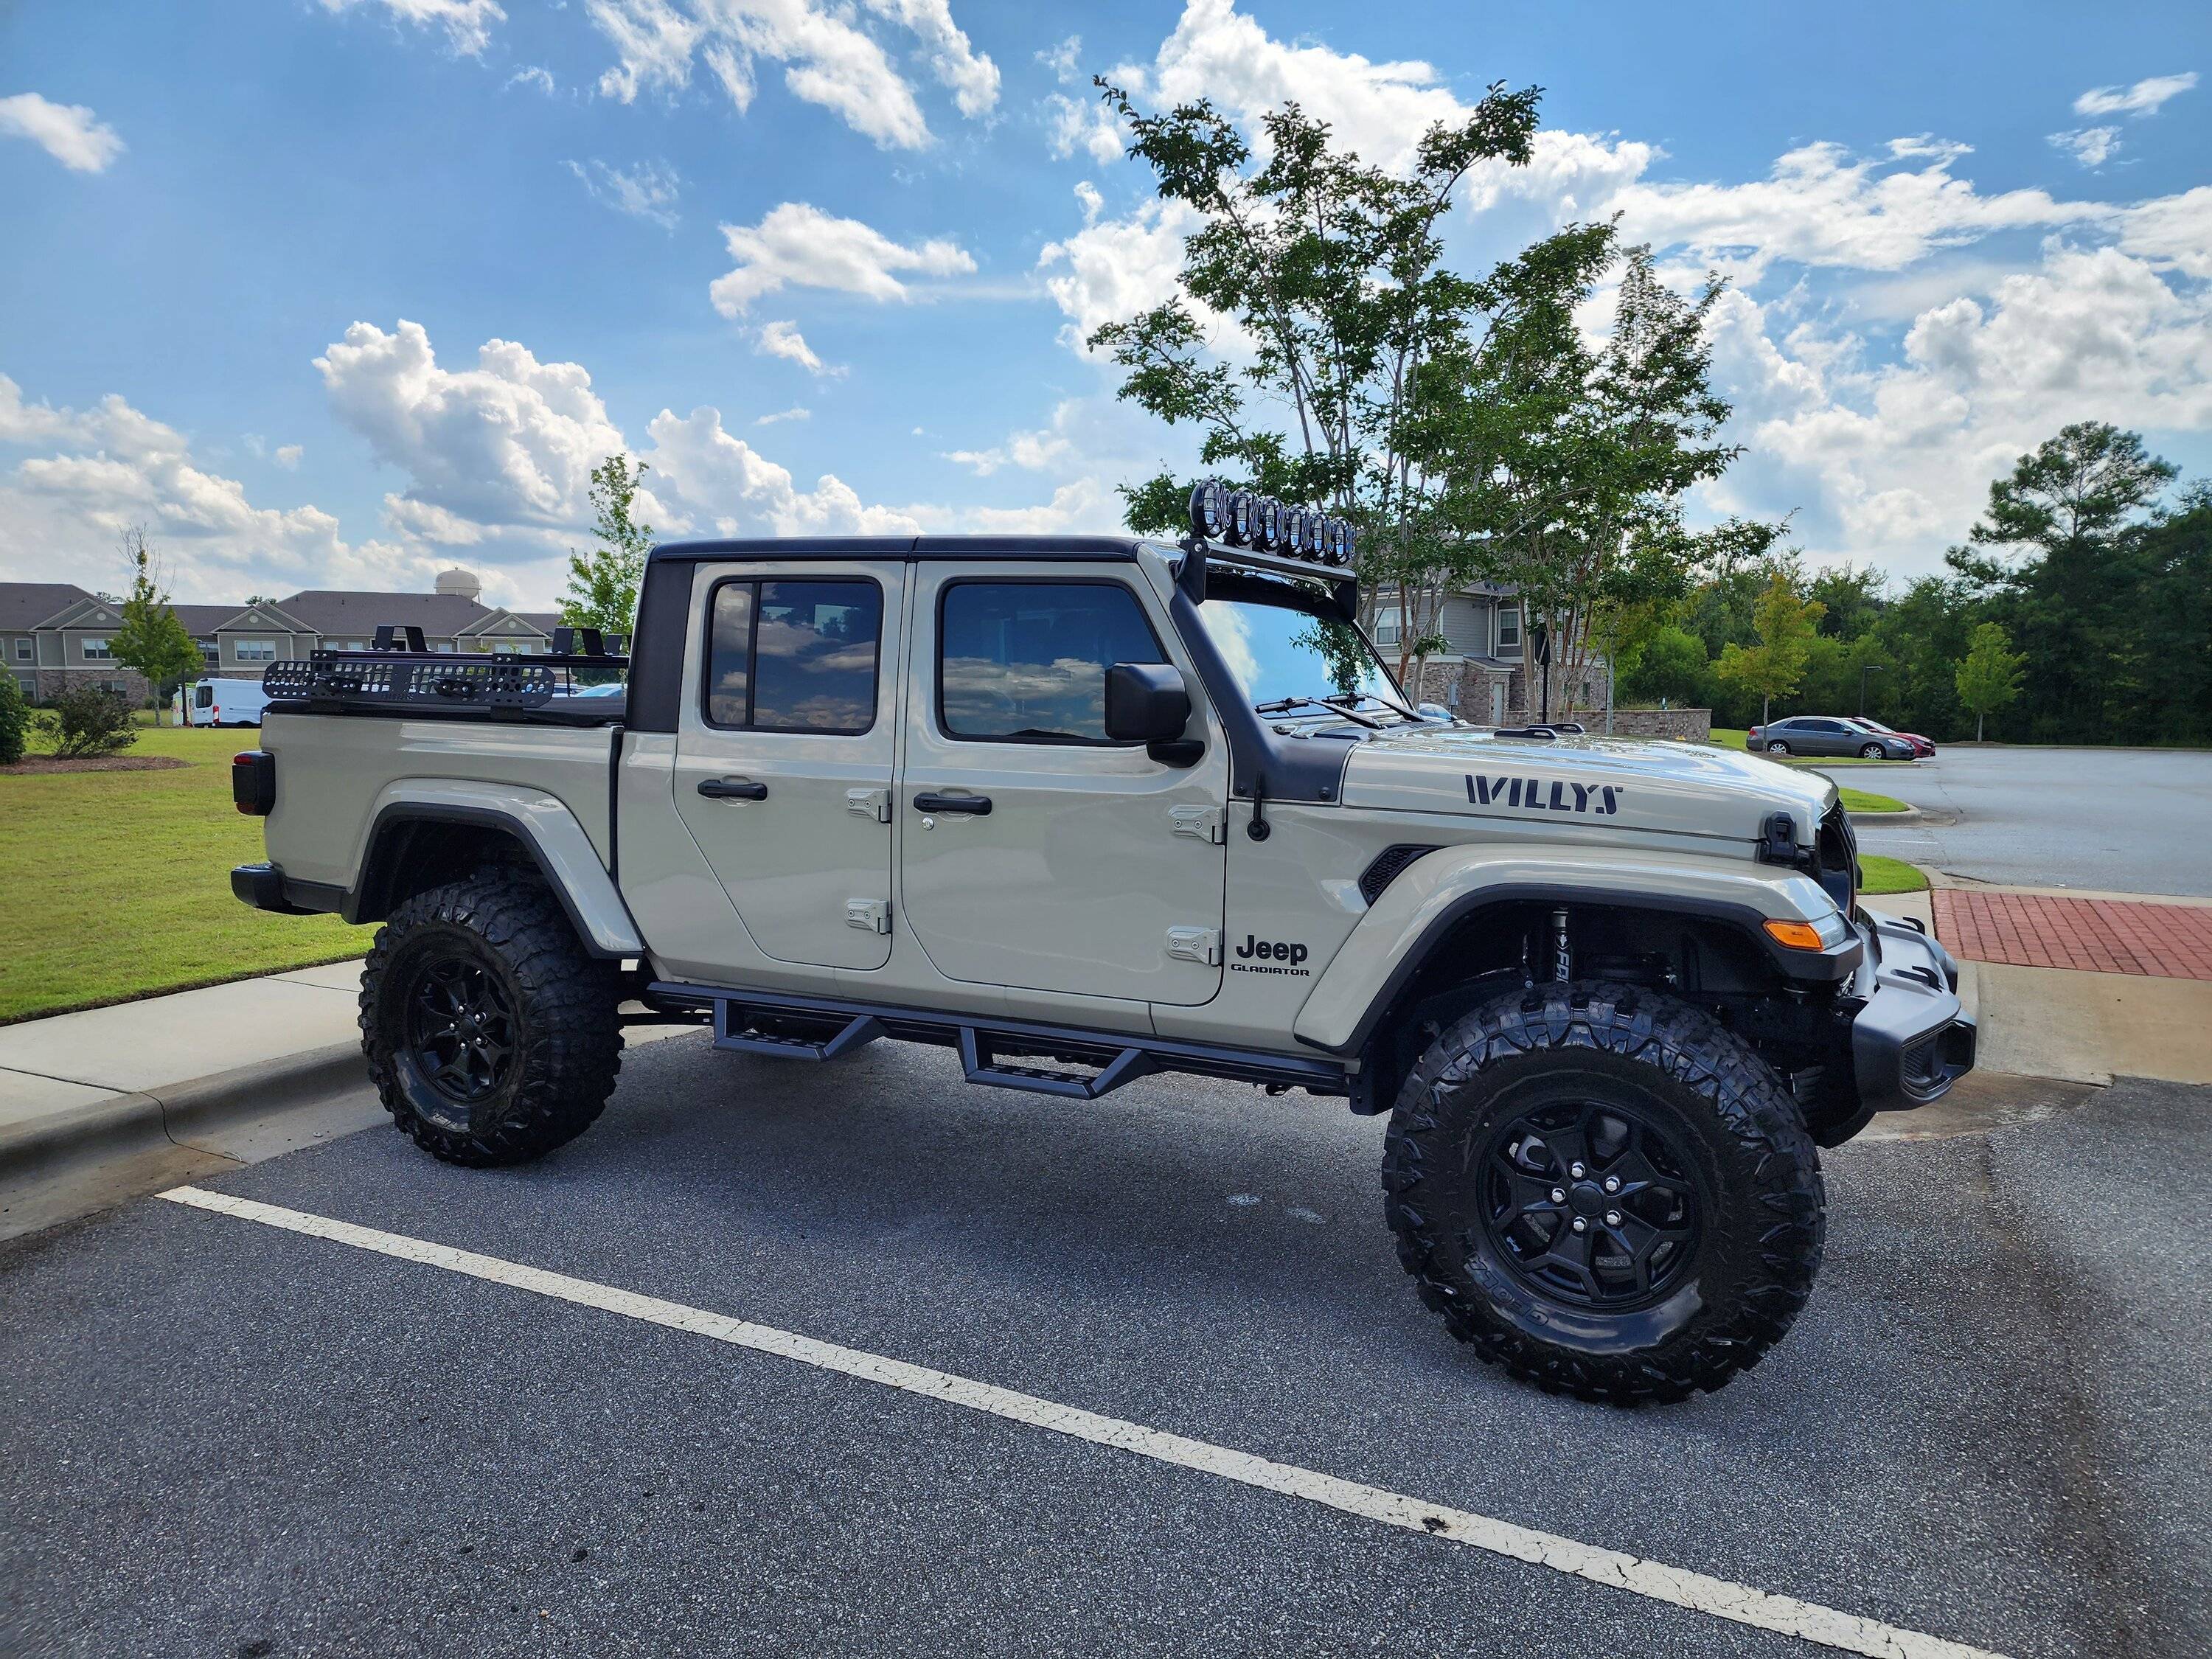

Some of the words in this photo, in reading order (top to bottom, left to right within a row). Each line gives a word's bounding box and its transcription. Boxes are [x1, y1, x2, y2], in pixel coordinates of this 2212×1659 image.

[1216, 484, 1232, 529] KC
[1465, 774, 1624, 815] WILLYS
[1236, 935, 1308, 966] Jeep
[1231, 964, 1310, 977] GLADIATOR
